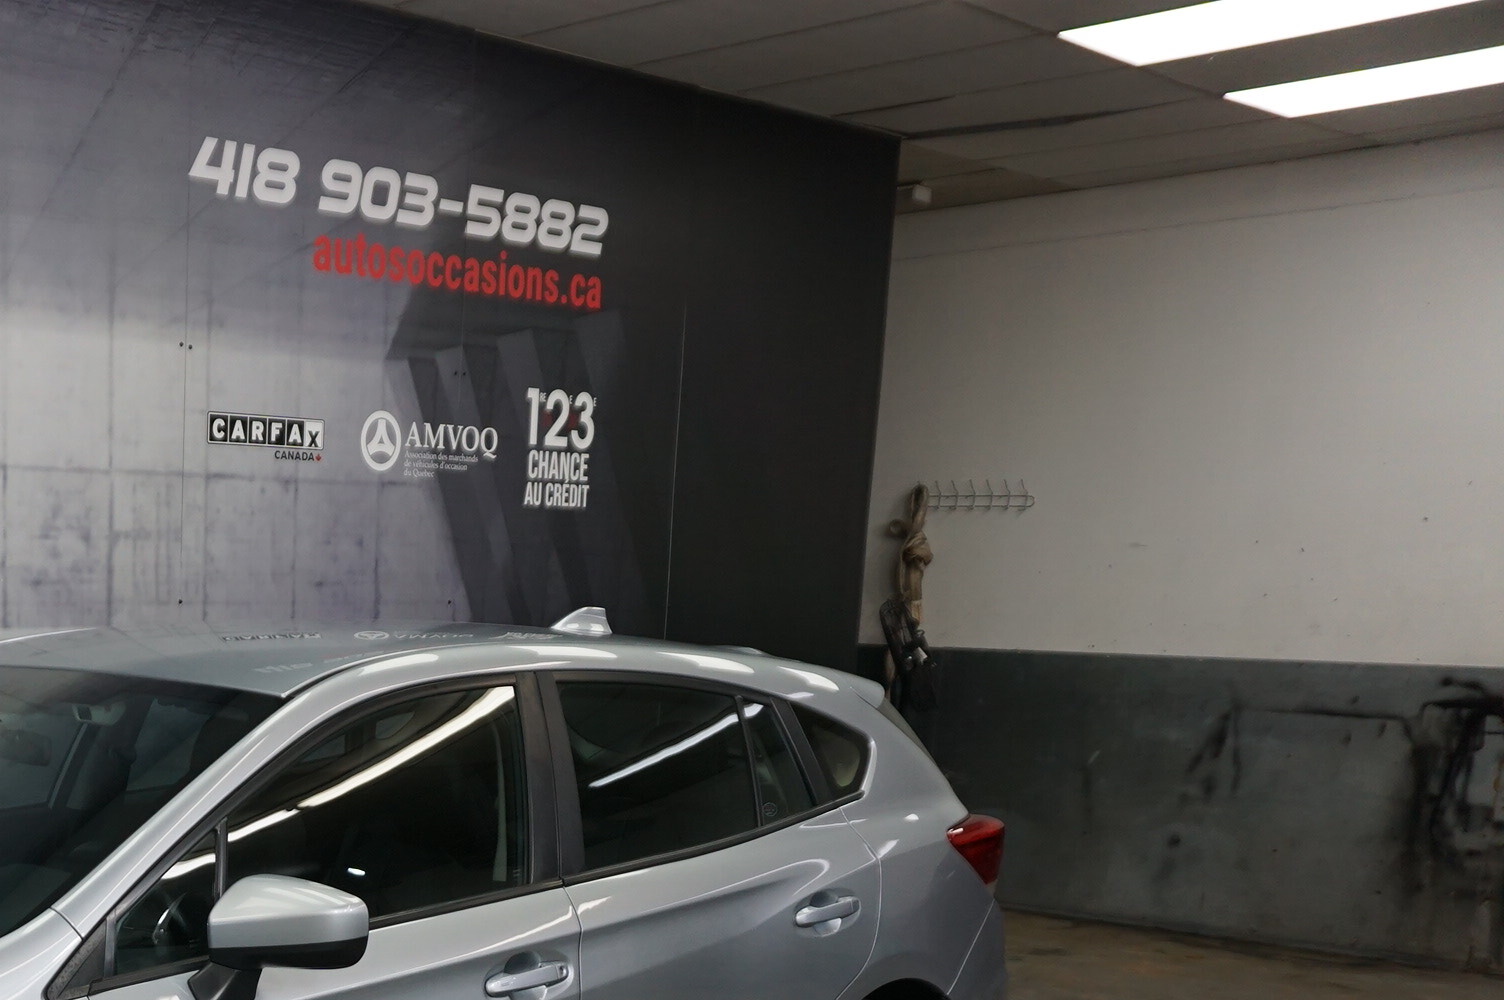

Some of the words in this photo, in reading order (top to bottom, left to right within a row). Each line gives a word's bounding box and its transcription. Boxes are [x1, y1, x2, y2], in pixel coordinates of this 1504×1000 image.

[188, 136, 300, 204] 418
[318, 158, 609, 257] 903-5882
[313, 233, 602, 310] autosoccasions.ca
[212, 418, 320, 447] CARFAX
[405, 421, 499, 459] AMVOQ
[274, 450, 315, 461] CANADA
[528, 450, 590, 481] CHANCE
[524, 482, 543, 506] AU
[545, 479, 590, 508] CRÉDIT
